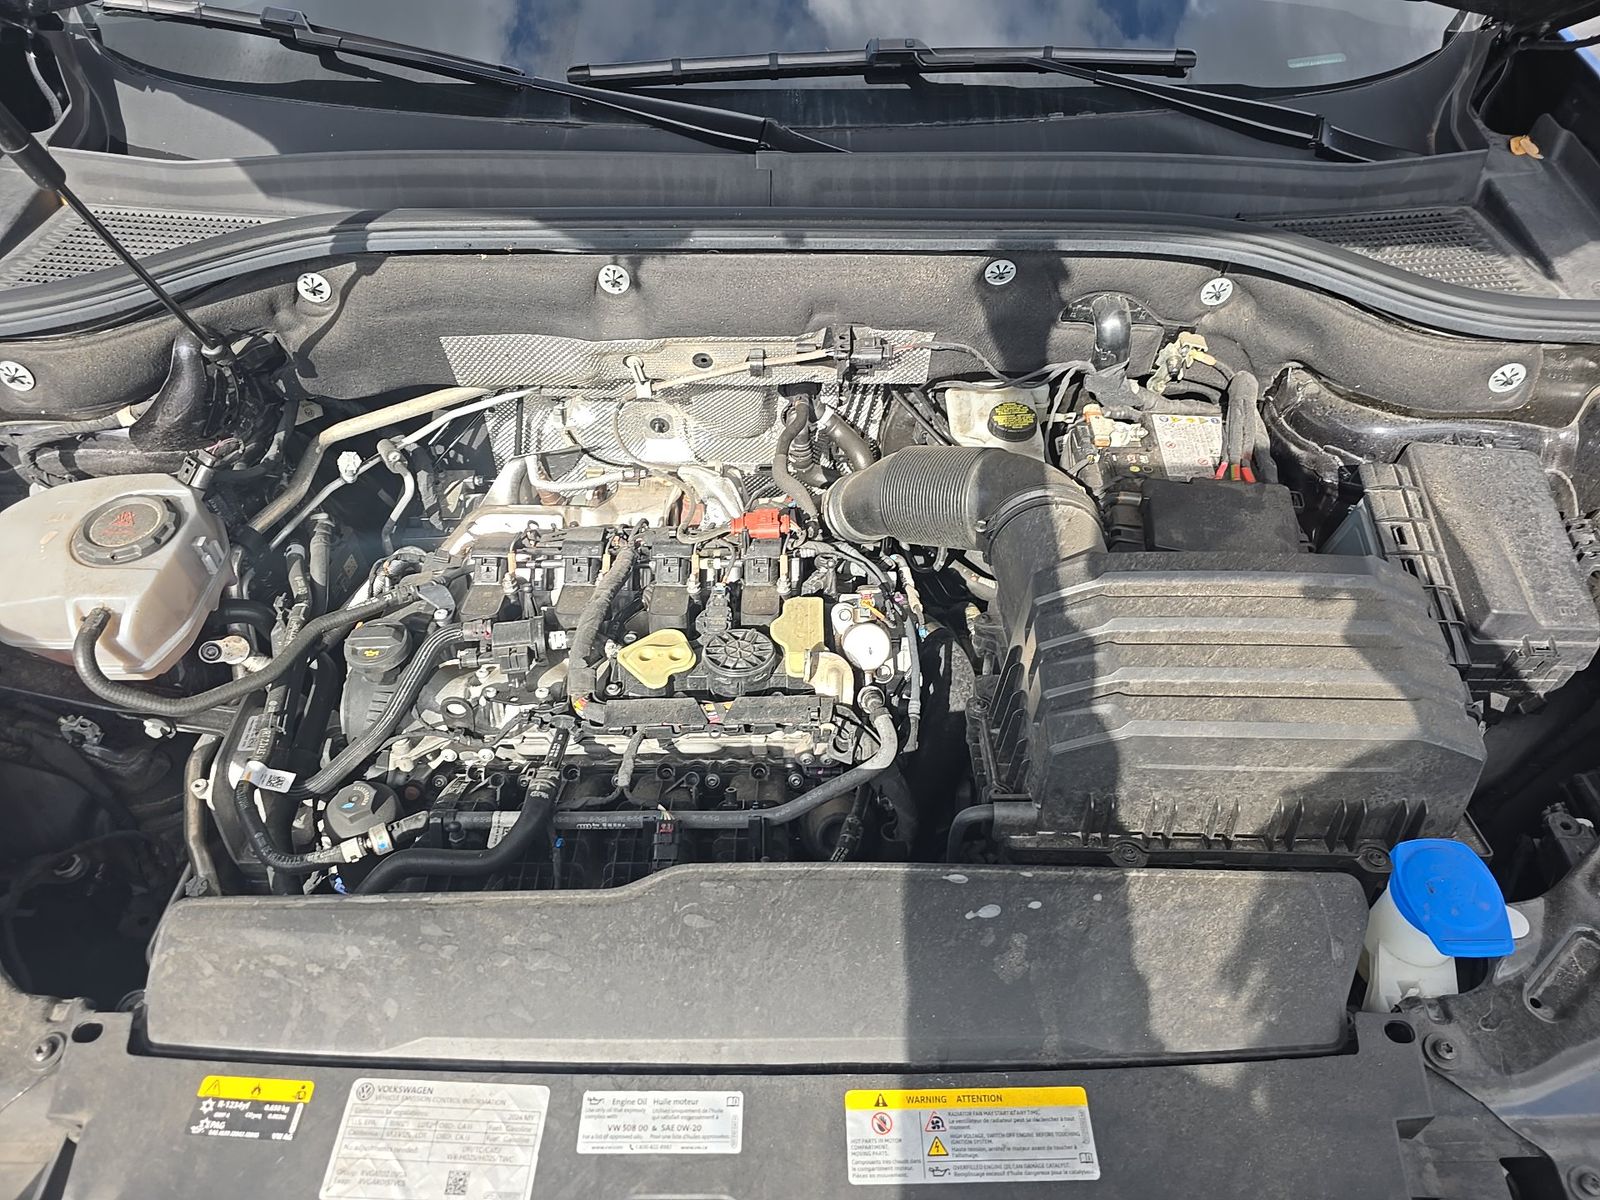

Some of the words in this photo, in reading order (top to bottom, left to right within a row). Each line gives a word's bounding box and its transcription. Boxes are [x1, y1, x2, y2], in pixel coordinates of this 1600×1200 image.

[378, 1085, 434, 1094] VOLKSWAGEN
[433, 1096, 460, 1104] CONTROL
[462, 1098, 507, 1106] INFORMATION
[612, 1098, 635, 1106] Engine
[905, 1096, 947, 1104] WARNING
[217, 1100, 252, 1111] R-1234yf
[210, 1121, 226, 1130] PAG
[608, 1124, 621, 1132] VW
[623, 1124, 636, 1132] 508
[638, 1124, 649, 1132] 00
[661, 1124, 675, 1132] SAE
[677, 1124, 702, 1132] 0W-20
